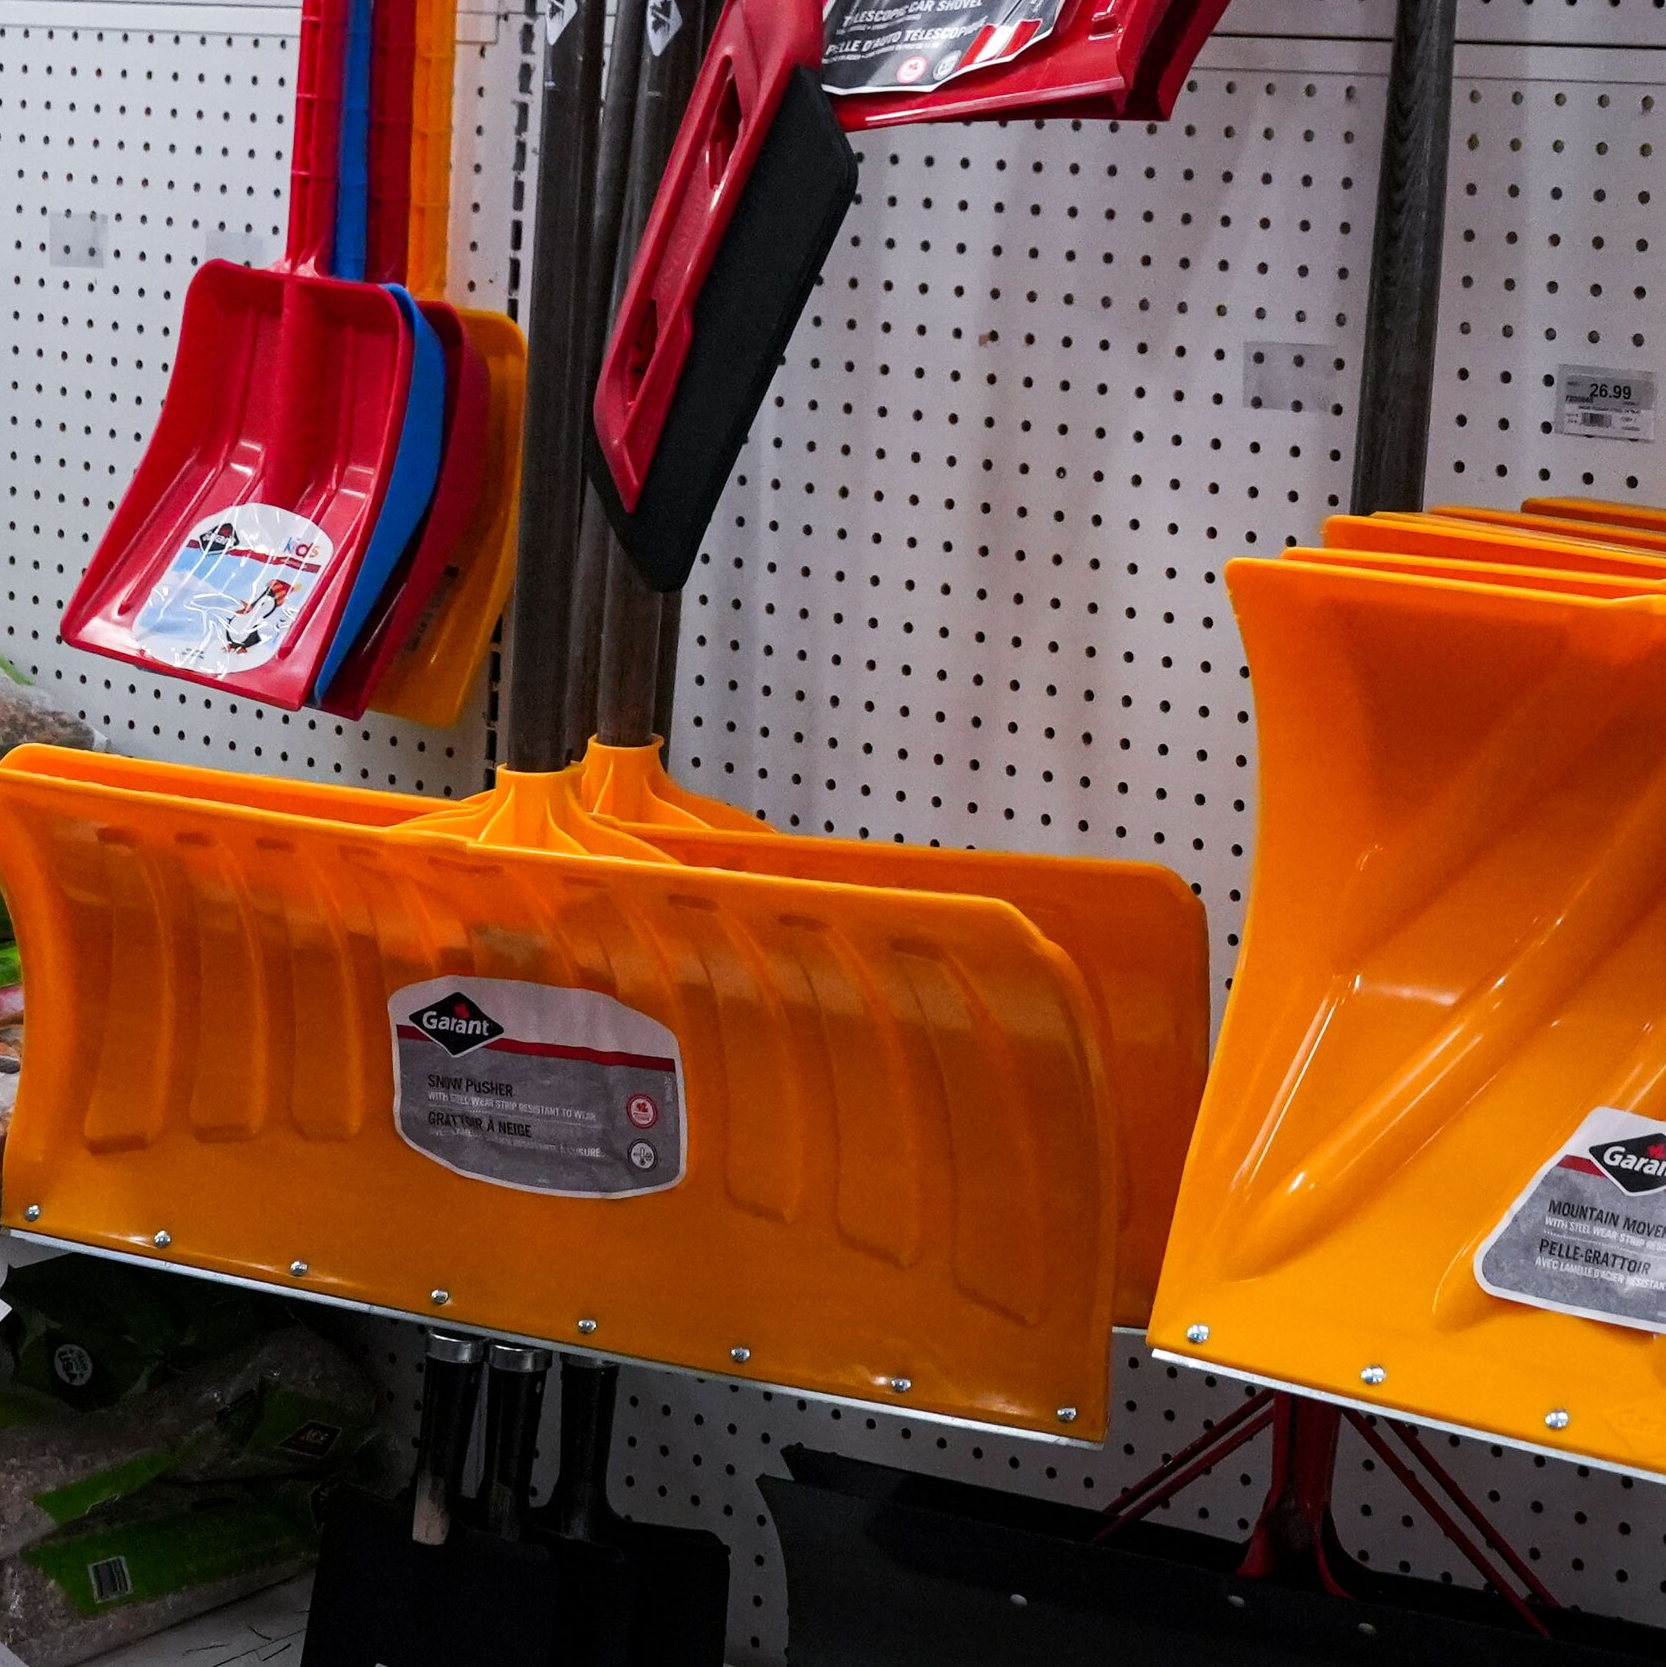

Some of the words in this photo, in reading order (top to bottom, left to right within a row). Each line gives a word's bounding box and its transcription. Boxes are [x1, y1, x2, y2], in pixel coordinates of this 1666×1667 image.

[1589, 383, 1632, 400] 26.99
[283, 535, 320, 559] kids
[421, 1010, 491, 1037] Garant
[427, 1074, 463, 1089] SNOW
[464, 1079, 513, 1097] PUSHER
[561, 1109, 572, 1117] TO
[1546, 1199, 1620, 1227] MOUNTAIN
[1543, 1216, 1568, 1230] WITH
[1567, 1221, 1591, 1234] STEEL
[1591, 1226, 1618, 1240] WEAR
[1617, 1232, 1645, 1247] STRIP
[1534, 1255, 1559, 1270] AVEC
[1537, 1238, 1652, 1275] PELLE-GRATTOIR
